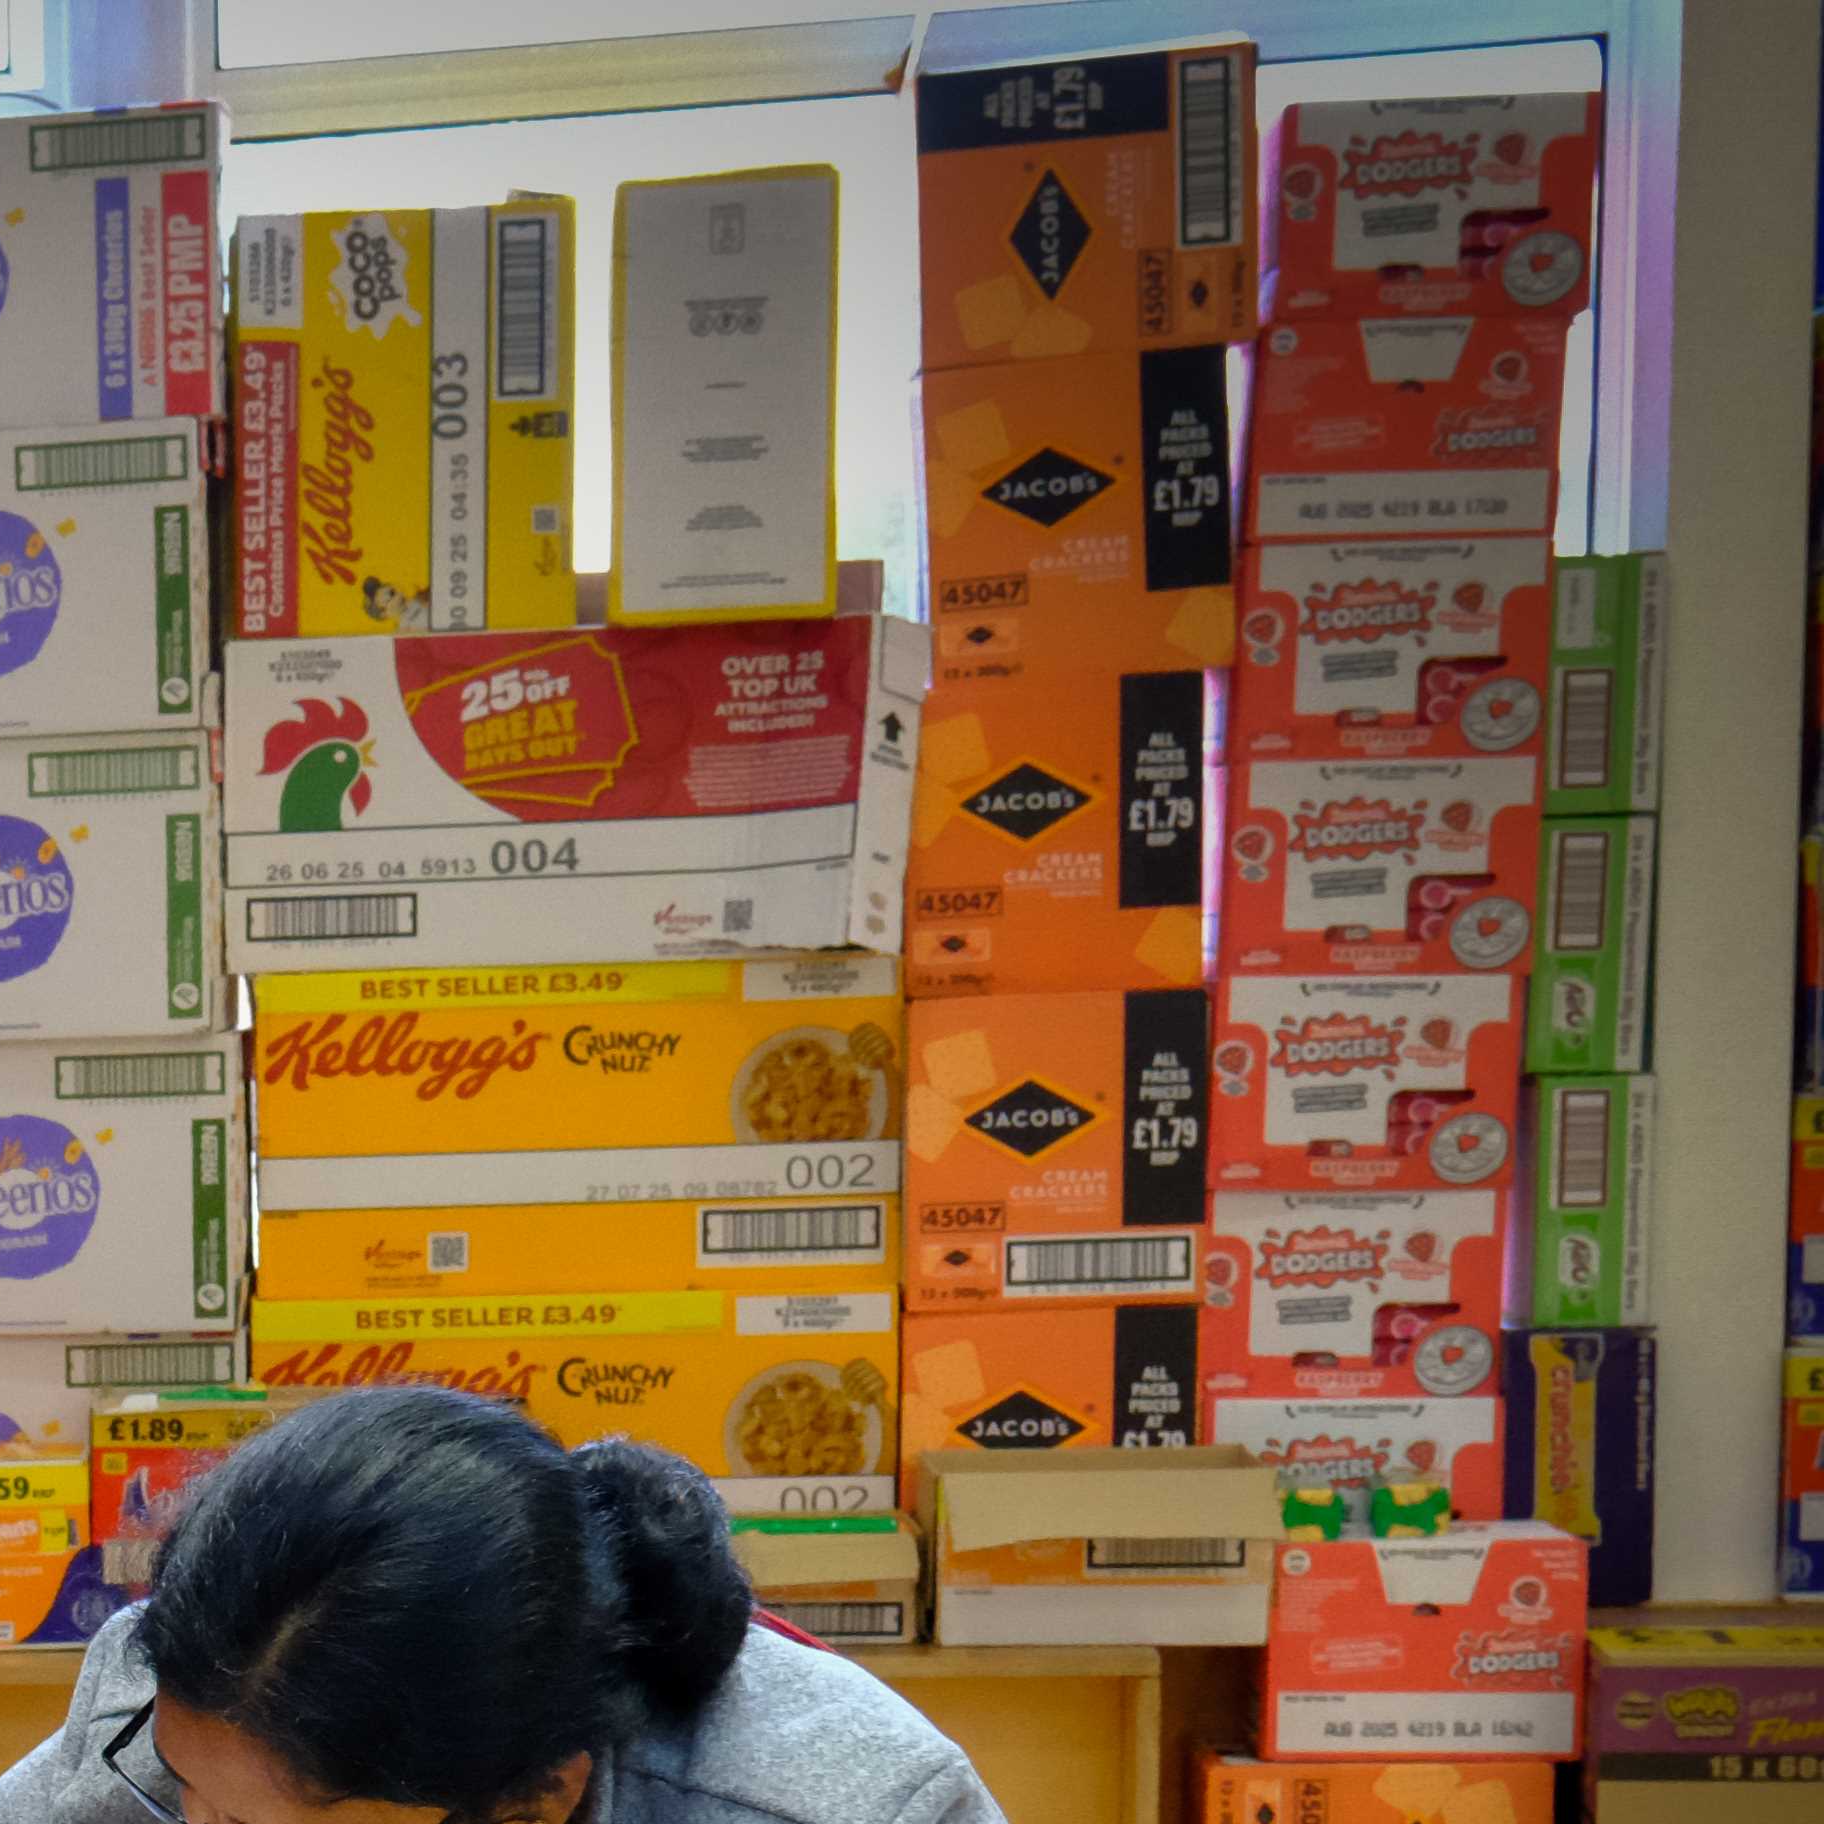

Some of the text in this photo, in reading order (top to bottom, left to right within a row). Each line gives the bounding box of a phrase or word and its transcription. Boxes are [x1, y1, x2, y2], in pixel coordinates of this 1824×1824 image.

[167, 214, 206, 298] PMP
[372, 235, 404, 302] pops
[344, 229, 381, 321] coco
[432, 352, 469, 440] 003
[300, 354, 376, 586] Kellogg's
[242, 441, 266, 551] SELLER
[1154, 475, 1219, 511] £1.79
[242, 557, 266, 632] BEST
[944, 579, 1023, 604] 45047
[721, 650, 825, 679] OVER 25
[460, 671, 526, 722] 25
[527, 674, 570, 702] OFF
[729, 673, 818, 699] TOP UK
[463, 702, 579, 753] GREAT
[1128, 797, 1194, 831] £1.79
[265, 855, 477, 882] 26 06 25 04 5913
[490, 837, 580, 875] 004
[918, 891, 998, 914] 45047
[360, 976, 429, 1000] BEST
[436, 974, 540, 998] SELLER
[265, 1012, 542, 1101] Kellogg's
[562, 1024, 681, 1066] CRUNCHY
[600, 1050, 651, 1075] NUT
[1132, 1117, 1198, 1150] £1.79
[784, 1153, 876, 1190] 002
[925, 1205, 1002, 1228] 45047
[355, 1309, 424, 1331] BEST
[431, 1306, 534, 1329] SELLER
[556, 1356, 675, 1399] CRUNCHY
[593, 1382, 646, 1408] NUT
[109, 1417, 185, 1442] £1.89
